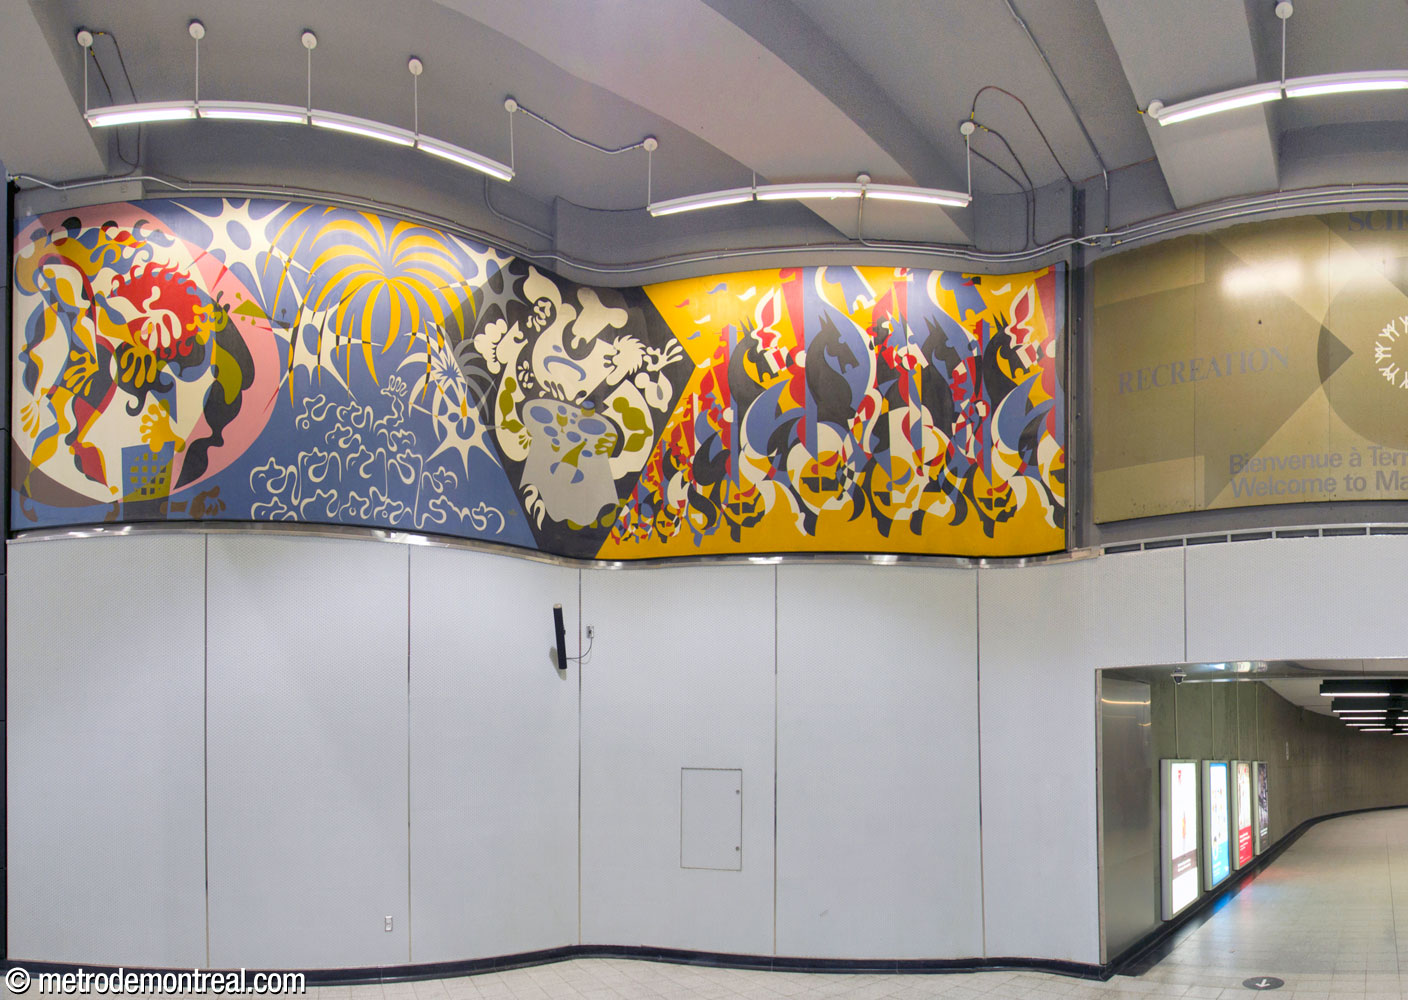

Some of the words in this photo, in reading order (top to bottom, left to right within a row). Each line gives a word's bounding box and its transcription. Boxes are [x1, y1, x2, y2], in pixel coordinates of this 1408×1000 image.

[1116, 346, 1289, 395] RECREATION
[1229, 451, 1342, 475] Bienvenue
[1349, 446, 1362, 468] à
[1232, 476, 1337, 498] Welcome
[1344, 473, 1367, 493] to
